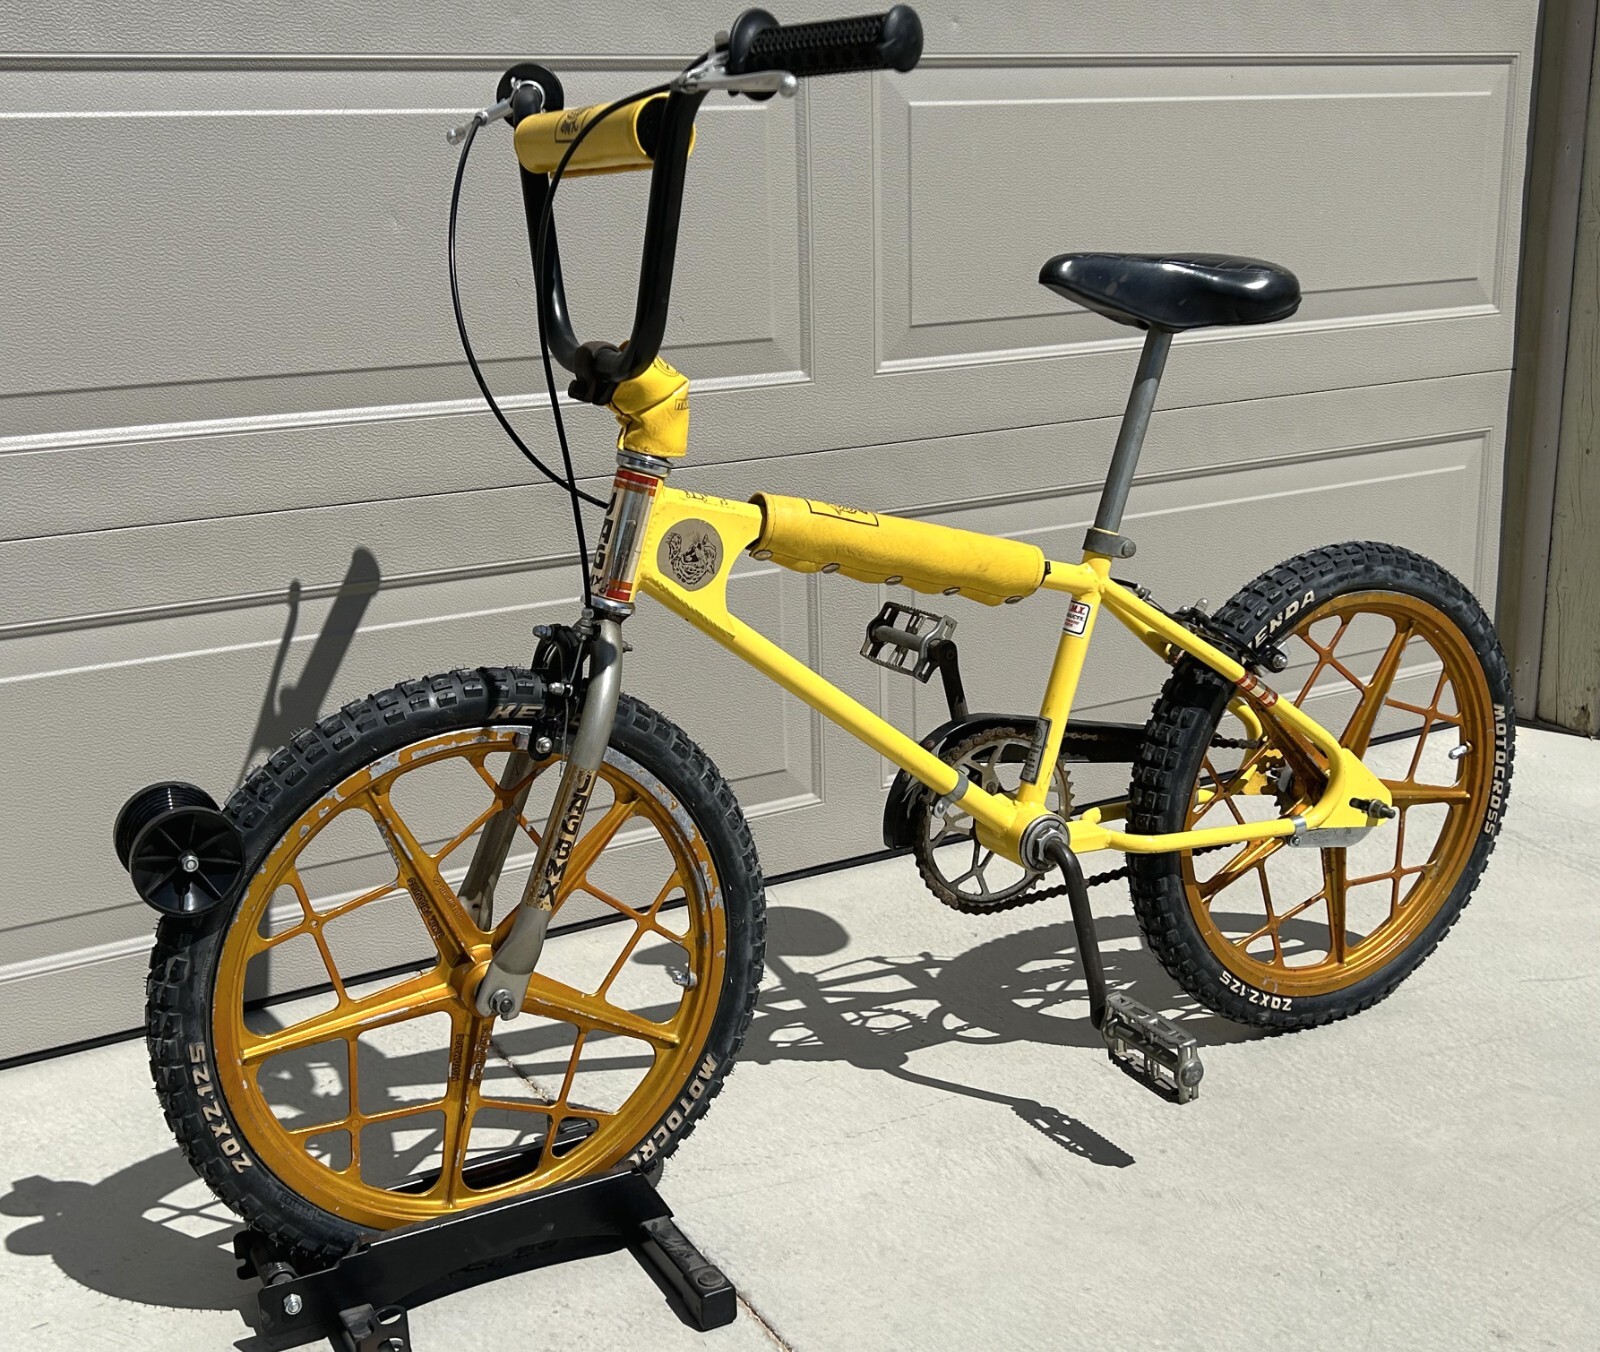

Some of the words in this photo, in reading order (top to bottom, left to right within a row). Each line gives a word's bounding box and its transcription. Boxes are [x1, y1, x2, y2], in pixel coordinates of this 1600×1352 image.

[1247, 590, 1316, 650] ENDA
[1484, 702, 1507, 836] MOTOCROSS
[538, 838, 573, 908] BMX
[1219, 970, 1293, 1012] 20X2.125
[188, 1041, 253, 1174] 20X2.125
[628, 1053, 718, 1167] MOTOCR
